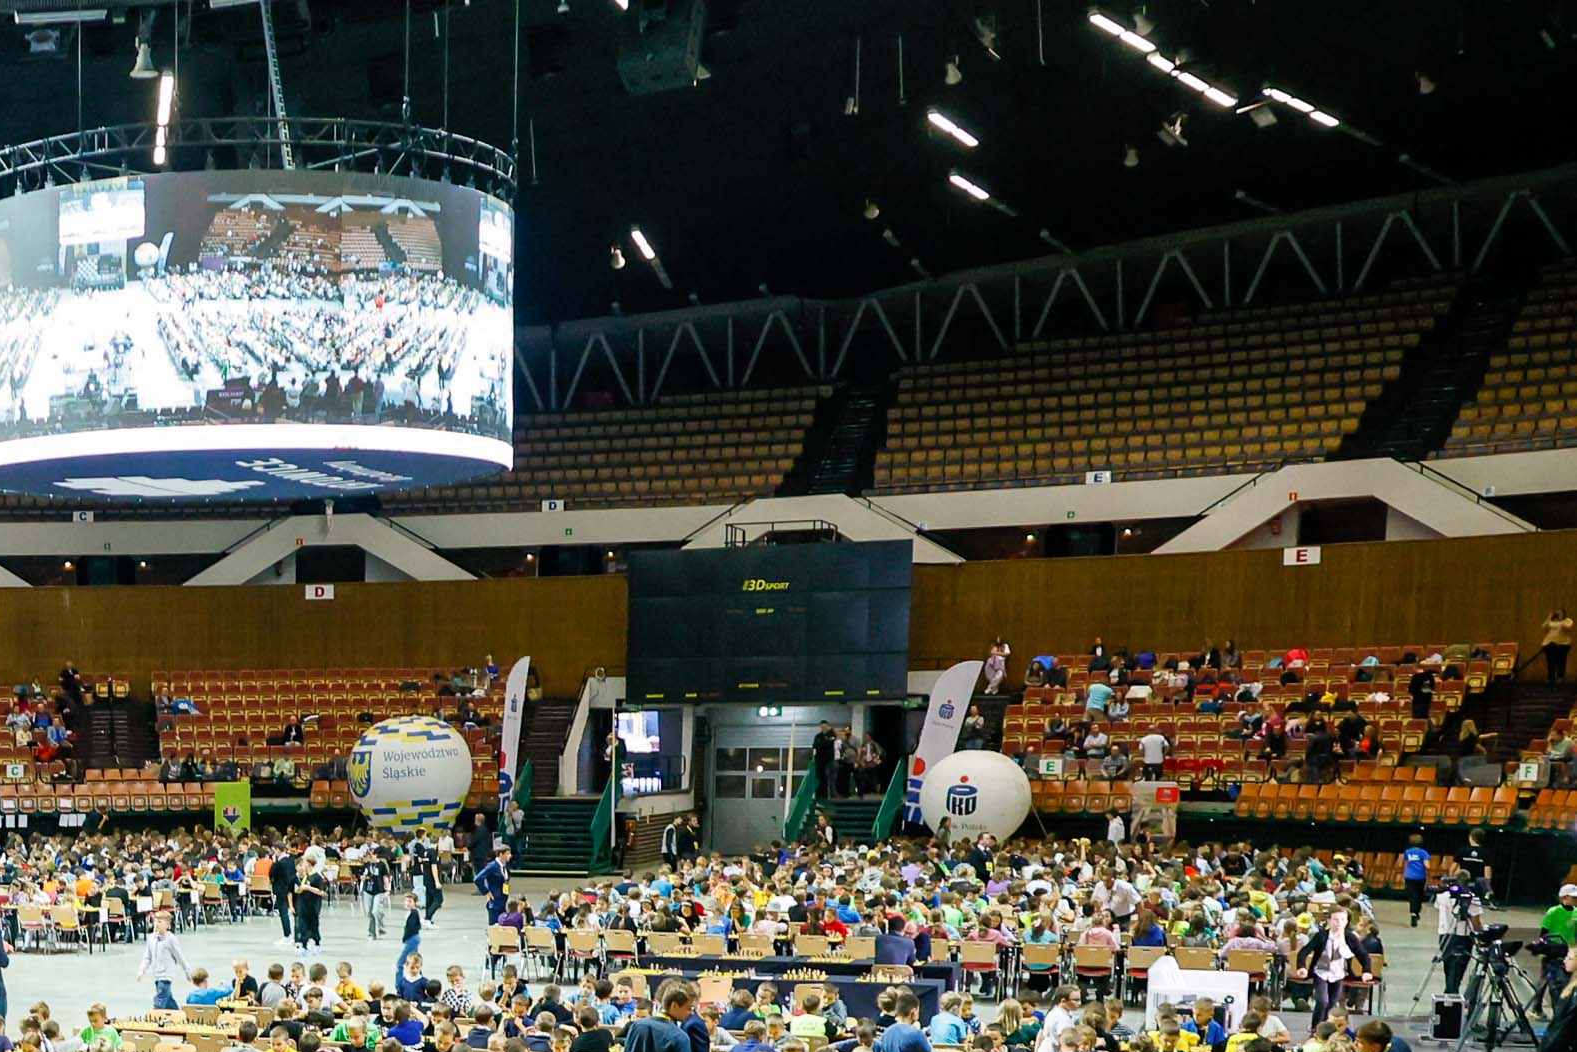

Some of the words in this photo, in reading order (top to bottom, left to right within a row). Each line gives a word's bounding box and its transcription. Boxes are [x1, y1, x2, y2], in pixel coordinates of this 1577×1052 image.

[1094, 473, 1103, 482] E
[549, 501, 557, 510] D
[79, 512, 87, 520] C
[1296, 549, 1308, 563] E
[314, 587, 325, 598] D
[382, 746, 459, 763] Województwo
[11, 766, 19, 775] C
[1046, 761, 1055, 771] E
[382, 765, 427, 782] Śląskie
[1524, 766, 1532, 779] F
